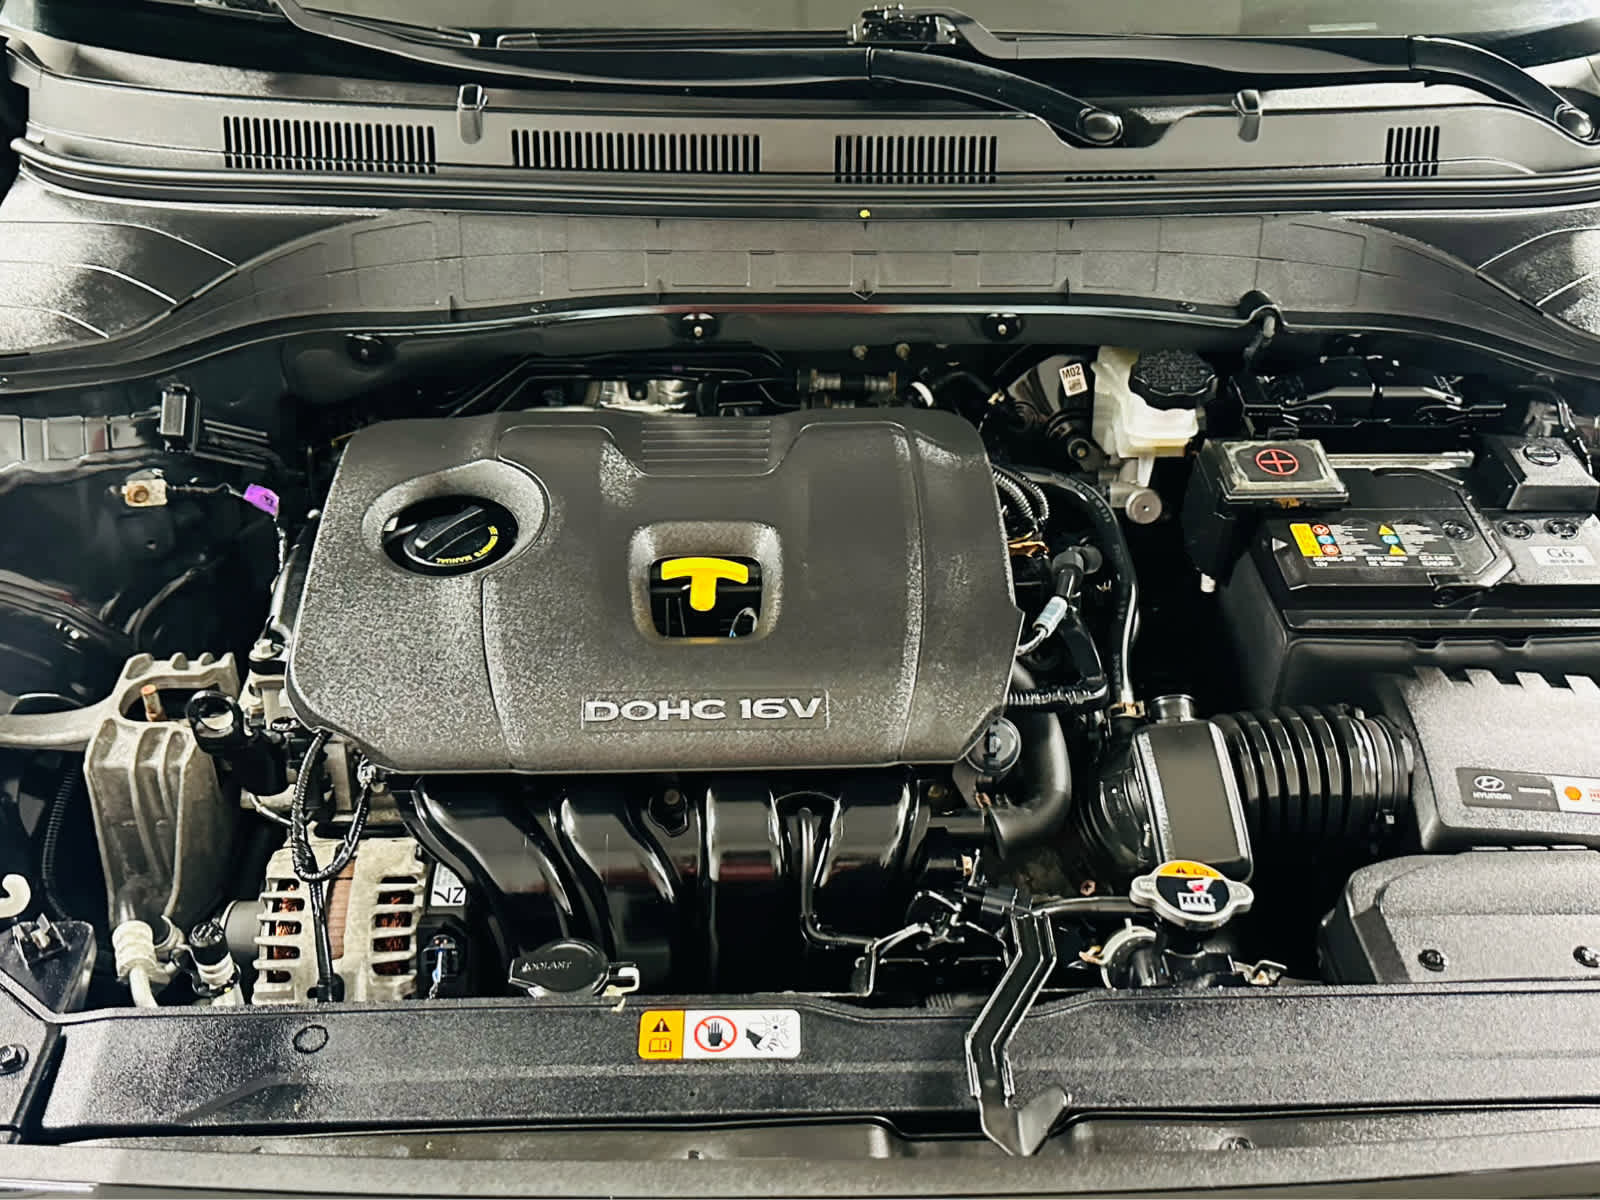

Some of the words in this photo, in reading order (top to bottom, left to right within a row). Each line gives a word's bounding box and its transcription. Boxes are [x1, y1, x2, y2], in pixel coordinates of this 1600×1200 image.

[1062, 365, 1081, 380] M02
[435, 554, 473, 564] MANUAL
[583, 698, 727, 722] DOHC
[739, 697, 822, 719] 16V
